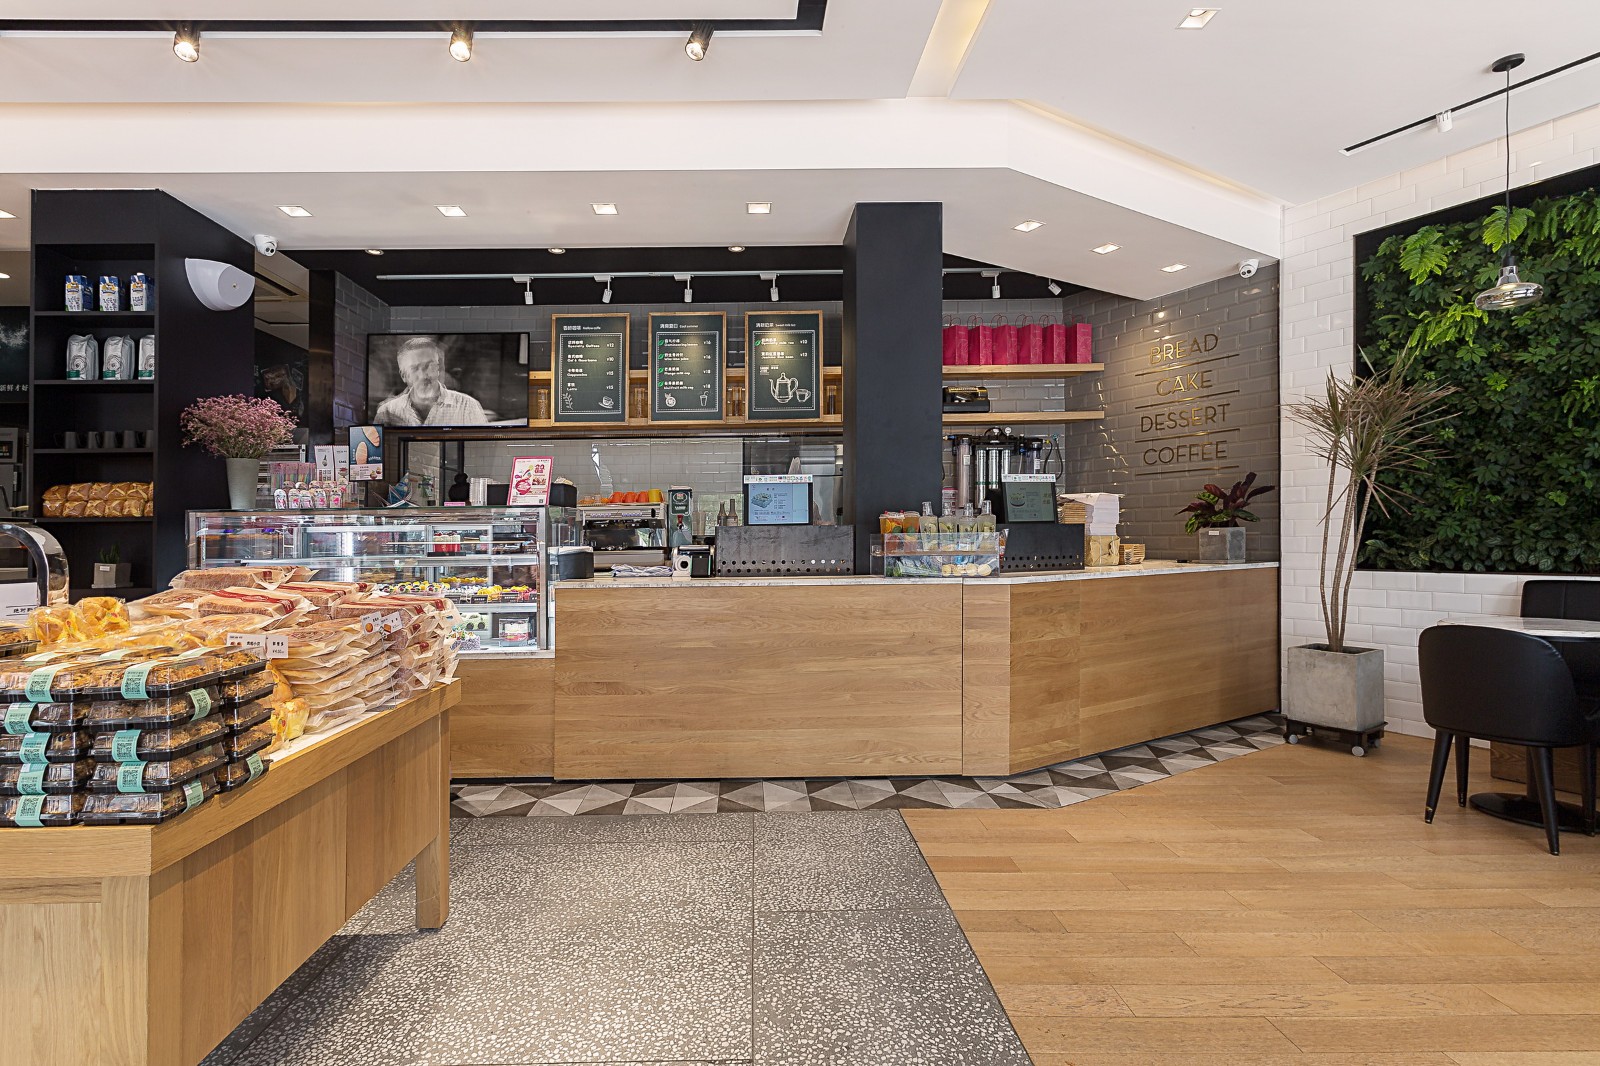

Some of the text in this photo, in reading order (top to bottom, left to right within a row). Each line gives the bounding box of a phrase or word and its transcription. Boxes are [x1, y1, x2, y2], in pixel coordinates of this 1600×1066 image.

[1150, 334, 1218, 365] BREAD
[1156, 370, 1213, 396] CAKE
[1140, 403, 1230, 433] DESSERT
[1143, 440, 1228, 466] COFFEE
